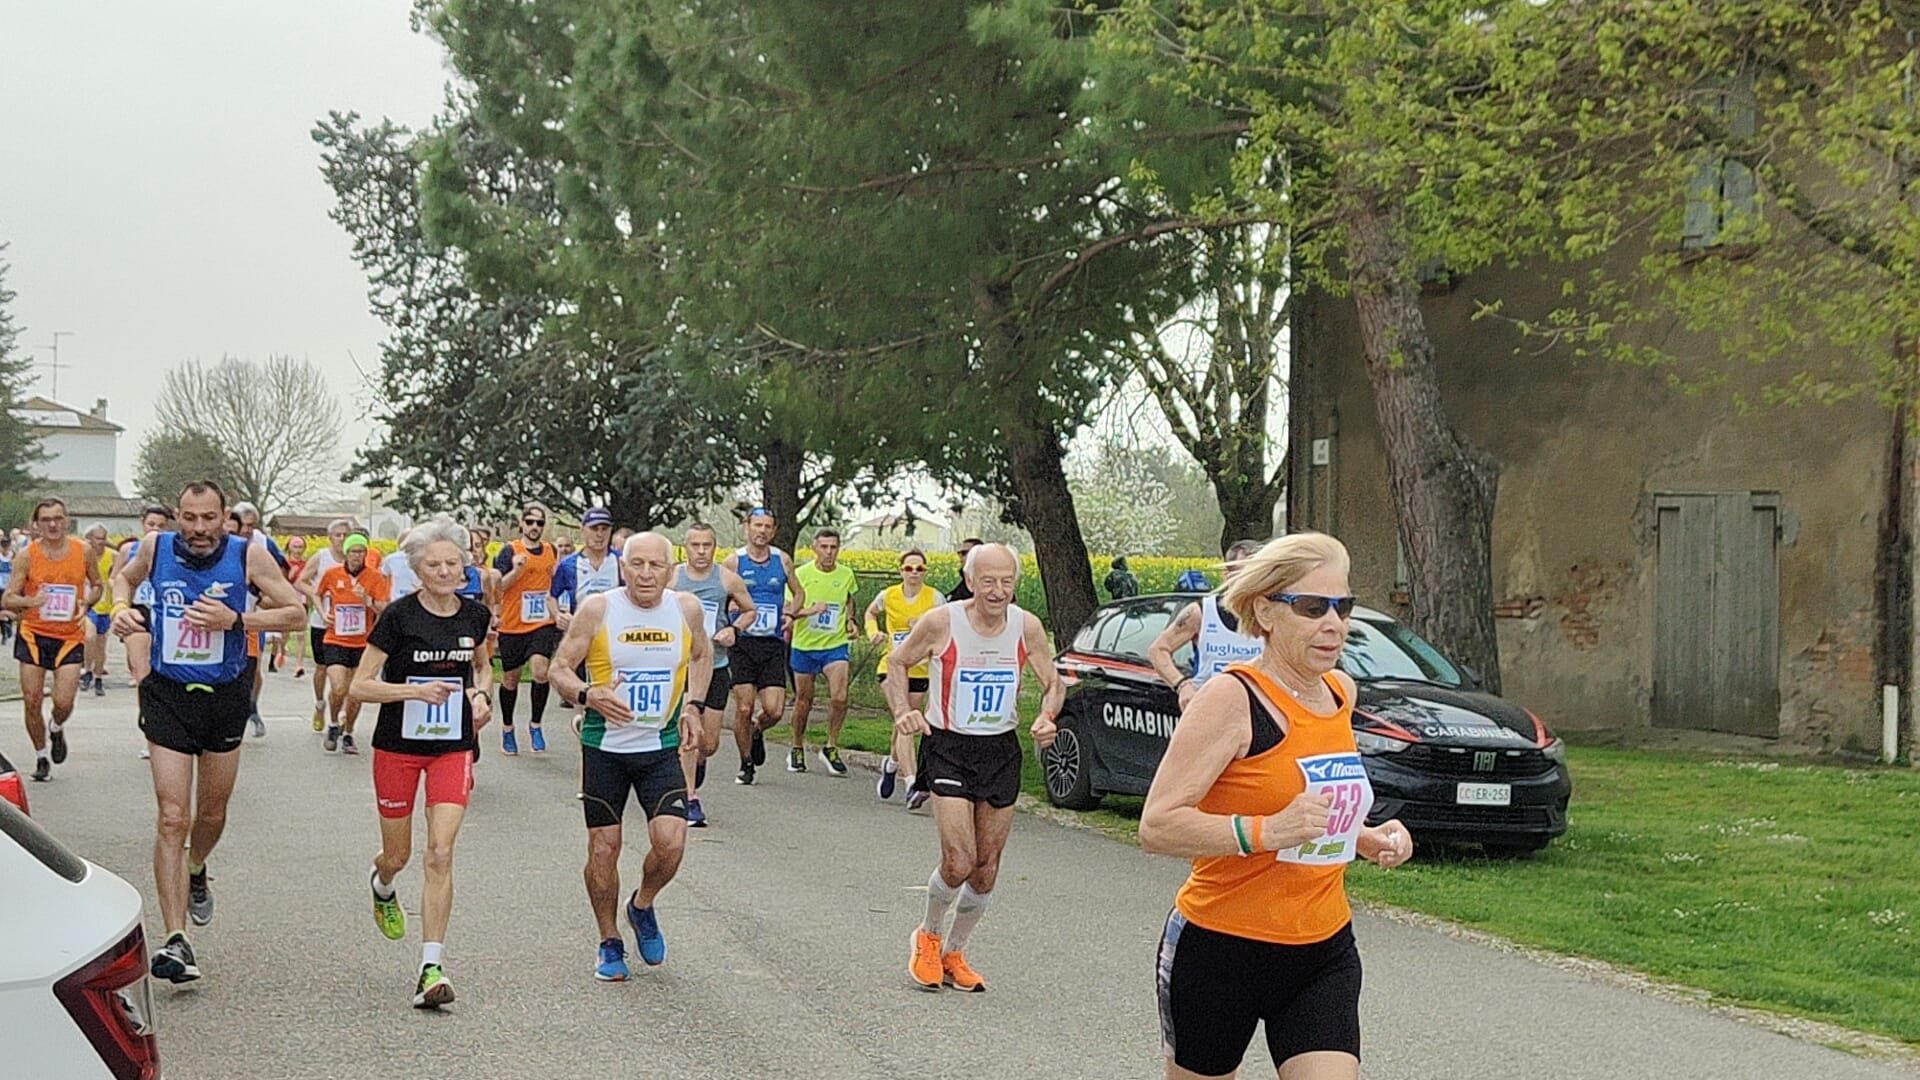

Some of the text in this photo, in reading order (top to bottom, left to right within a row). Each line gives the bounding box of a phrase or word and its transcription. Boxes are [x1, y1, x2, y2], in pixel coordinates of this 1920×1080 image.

[176, 618, 212, 649] 281
[624, 631, 670, 642] MAMELI
[412, 650, 446, 662] LOLLI
[627, 684, 662, 713] 194
[972, 684, 1006, 713] 197
[1472, 751, 1498, 772] FIAT
